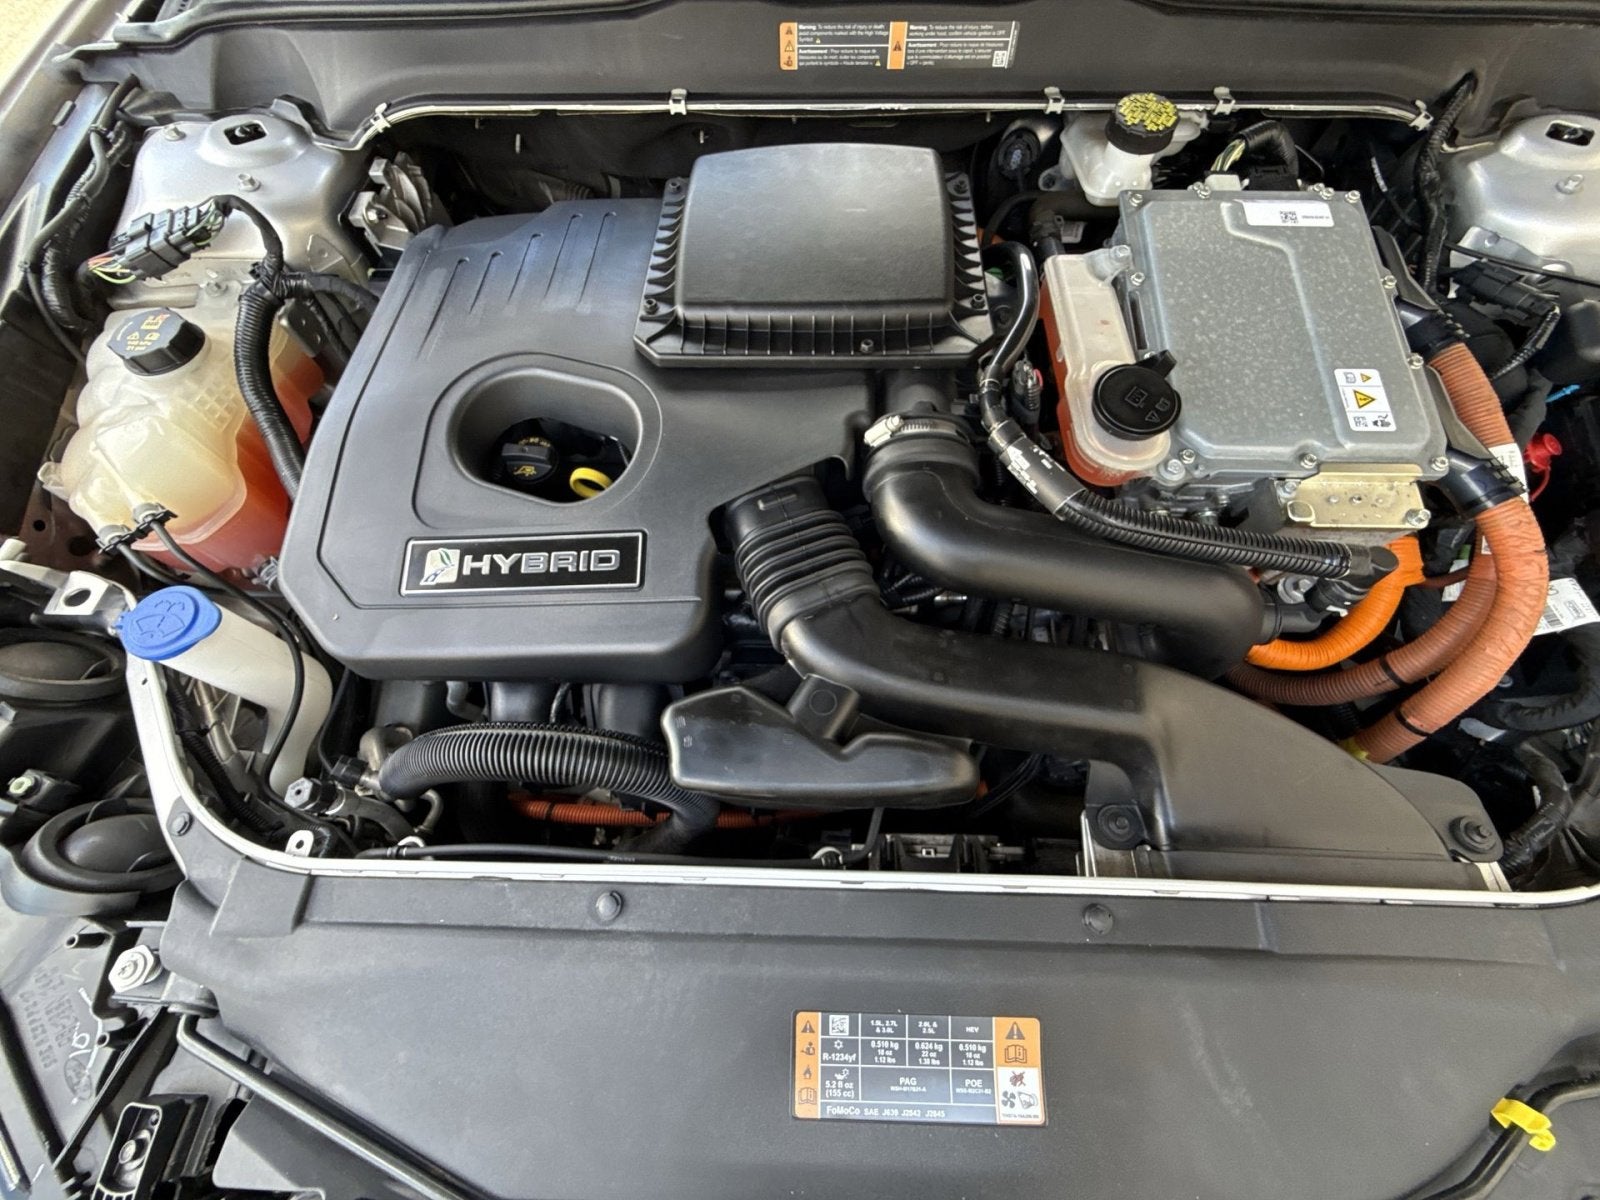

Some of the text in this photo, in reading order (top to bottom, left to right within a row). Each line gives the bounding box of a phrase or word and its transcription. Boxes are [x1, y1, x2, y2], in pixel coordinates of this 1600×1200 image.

[462, 549, 620, 575] HYBRID
[890, 1040, 899, 1050] kg
[934, 1042, 943, 1052] kg
[978, 1044, 986, 1054] kg
[822, 1052, 856, 1063] R-1234yf
[825, 1080, 837, 1088] 5.2
[899, 1076, 917, 1086] PAG
[964, 1078, 983, 1088] POE
[825, 1088, 854, 1100] (155 cc)
[826, 1105, 861, 1116] FoMoCo
[863, 1108, 879, 1116] SAE
